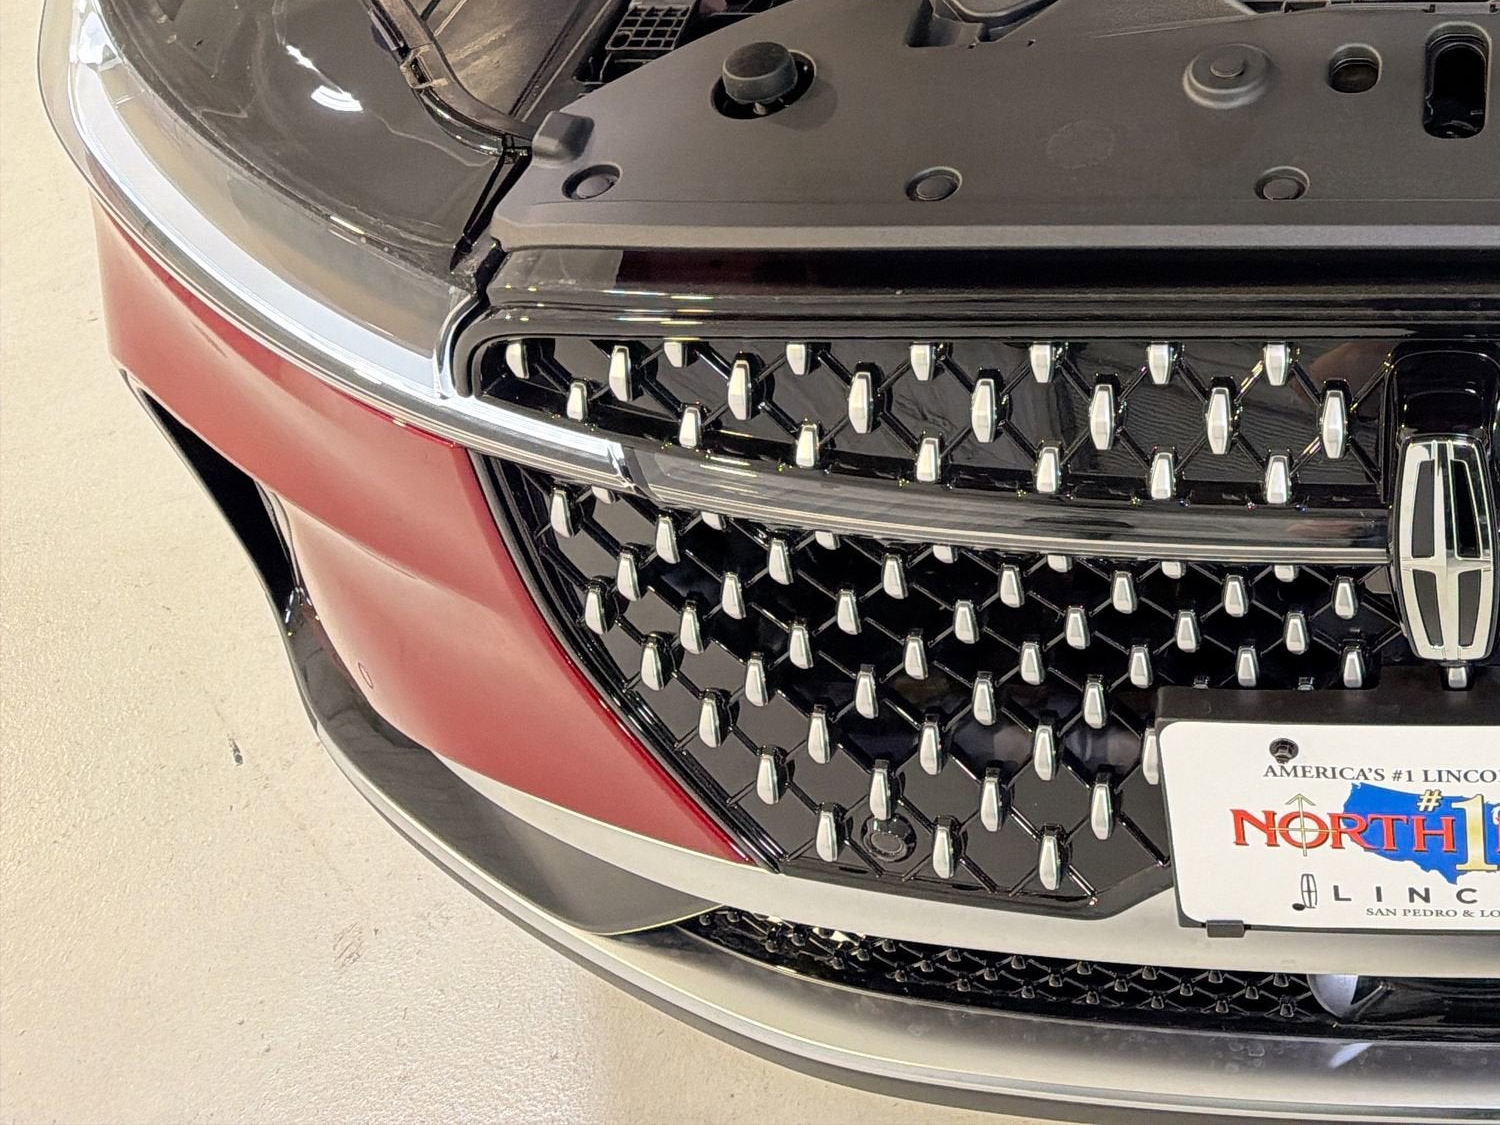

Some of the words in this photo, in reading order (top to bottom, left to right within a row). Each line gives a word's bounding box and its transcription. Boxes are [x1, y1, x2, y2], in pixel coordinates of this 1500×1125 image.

[1264, 764, 1385, 782] AMERICA'S
[1391, 769, 1413, 783] #1
[1229, 808, 1457, 853] NORTH
[1366, 907, 1397, 917] SAN
[1402, 908, 1458, 918] PEDRO
[1462, 909, 1476, 918] &
